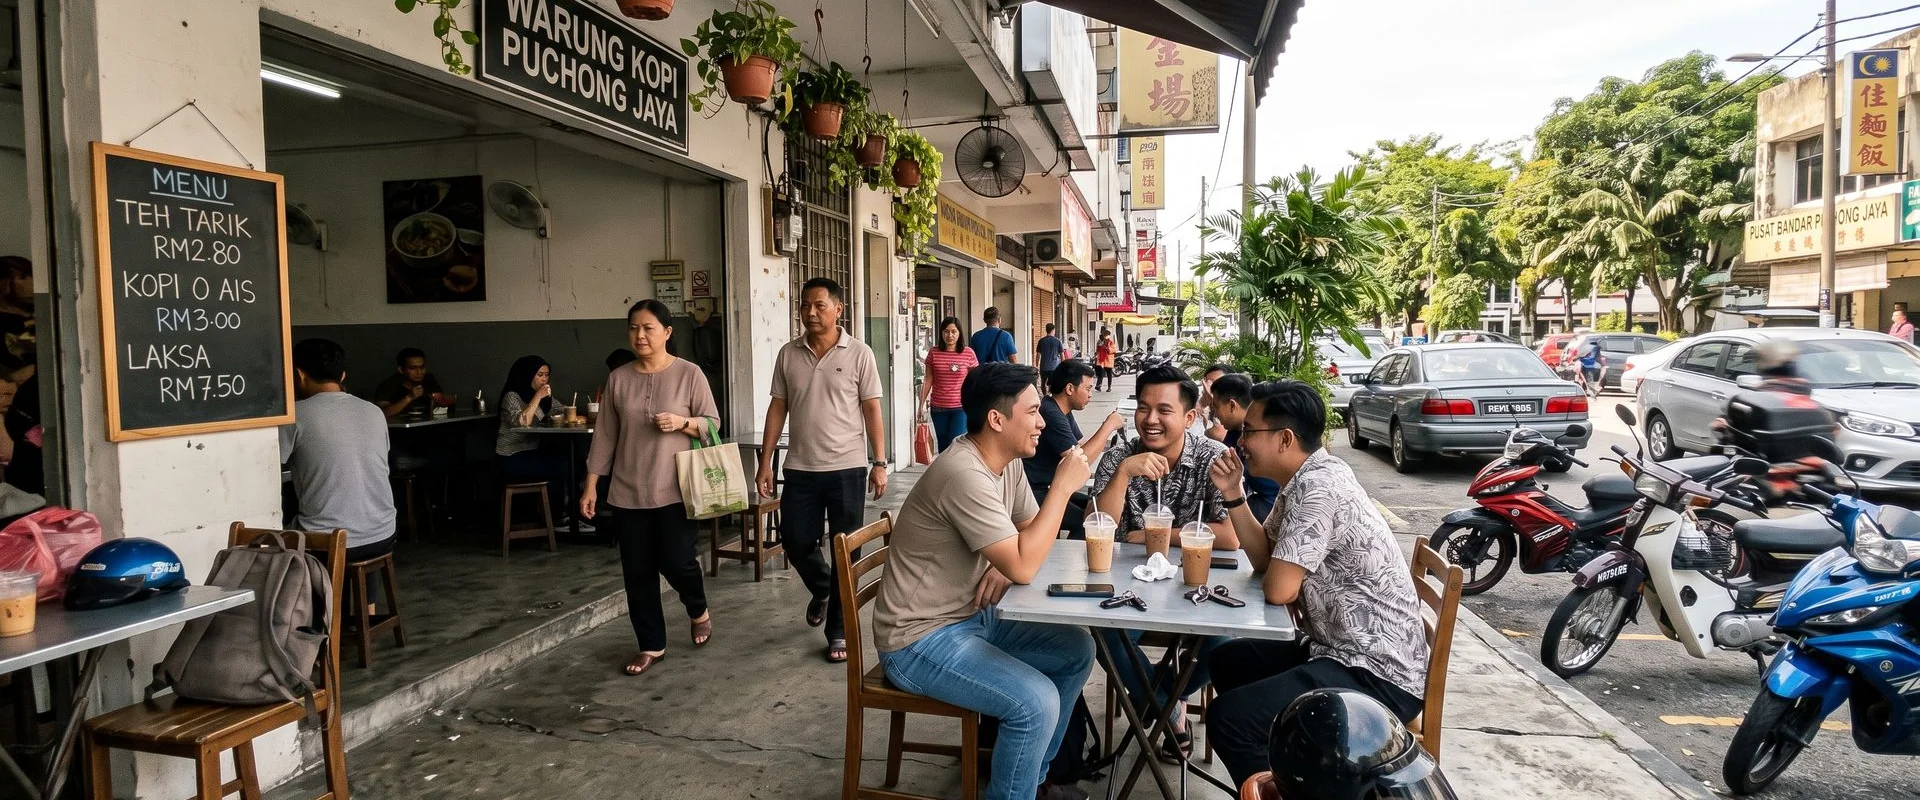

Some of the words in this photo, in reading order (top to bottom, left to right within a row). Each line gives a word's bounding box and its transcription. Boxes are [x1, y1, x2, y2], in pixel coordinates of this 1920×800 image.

[507, 0, 624, 72] WARUNG
[631, 45, 677, 98] KOPI
[503, 28, 627, 112] PUCHONG
[633, 89, 678, 134] JAYA
[153, 167, 227, 200] MENU
[116, 198, 170, 229] TEH
[180, 206, 252, 238] TARIK
[1750, 222, 1775, 239] PUSAT
[1777, 215, 1812, 235] BANDAR
[1815, 206, 1859, 229] PONG
[1863, 201, 1888, 221] JAYA
[154, 235, 240, 265] RM2.80
[123, 270, 180, 299] KOPI
[192, 276, 209, 300] O
[219, 278, 256, 303] AIS
[156, 307, 241, 332] RM3.00
[128, 343, 211, 369] LAKSA
[159, 374, 246, 403] RM7.50
